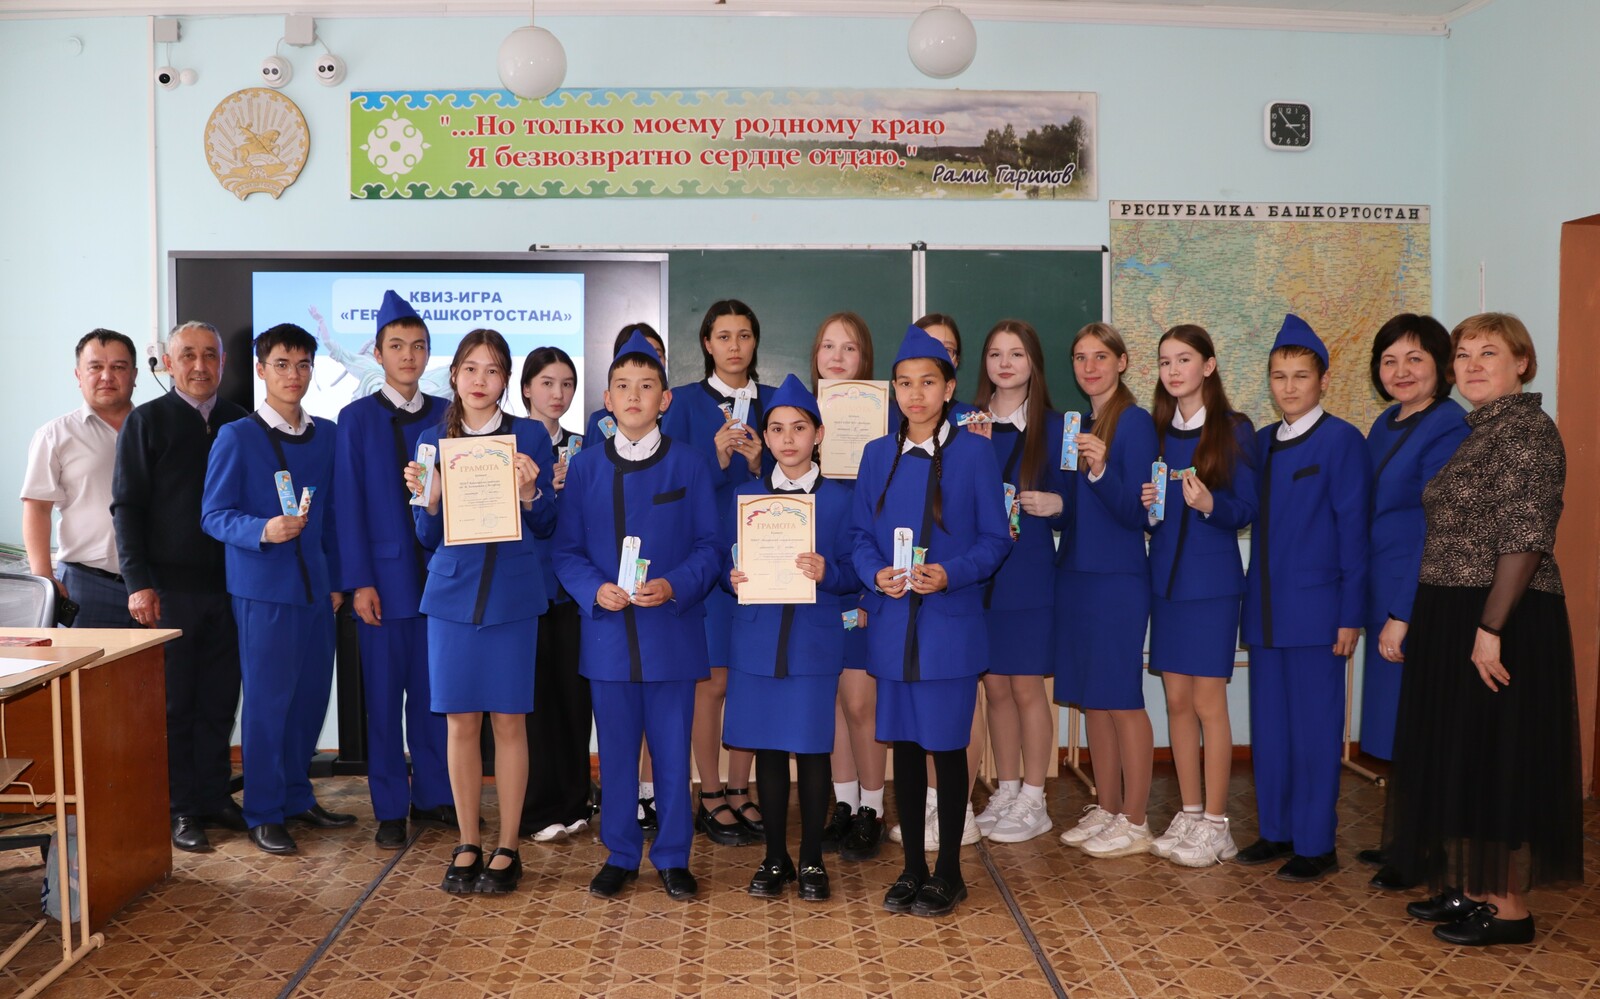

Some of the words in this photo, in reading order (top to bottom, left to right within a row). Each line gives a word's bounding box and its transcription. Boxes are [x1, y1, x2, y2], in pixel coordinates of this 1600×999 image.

[523, 117, 625, 136] только
[632, 117, 726, 140] моему
[734, 116, 870, 141] родному
[870, 117, 946, 141] краю
[466, 147, 487, 168] Я
[495, 145, 692, 174] безвозвратно
[699, 149, 801, 173] сердце
[808, 145, 918, 168] отдаю."
[932, 164, 988, 184] Рами
[995, 163, 1076, 190] Гарипов
[1120, 203, 1256, 217] РЕСПУБЛИКА
[1267, 205, 1420, 220] БАШКОРТОСТАН
[409, 291, 503, 304] КВИЗ-ИГРА
[340, 308, 381, 321] «ГЕР
[460, 464, 500, 472] ГРАМОТА
